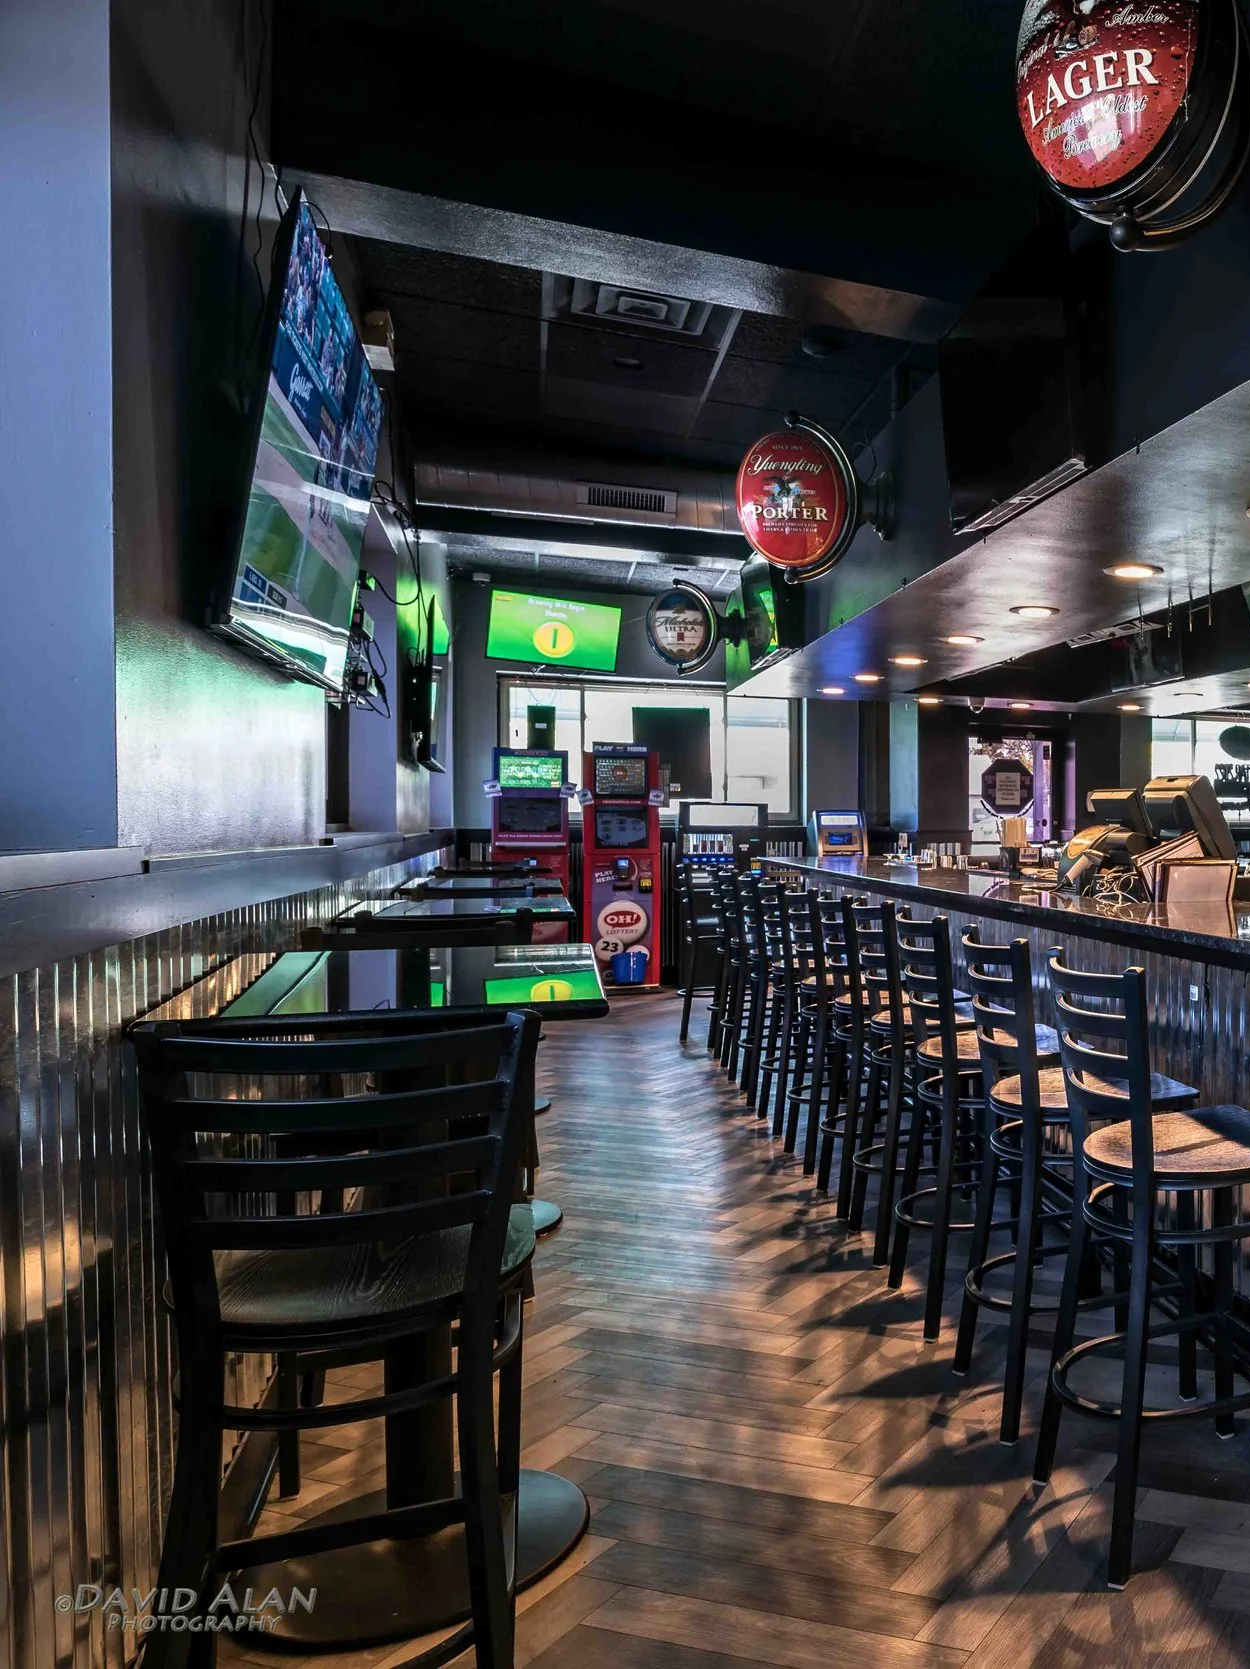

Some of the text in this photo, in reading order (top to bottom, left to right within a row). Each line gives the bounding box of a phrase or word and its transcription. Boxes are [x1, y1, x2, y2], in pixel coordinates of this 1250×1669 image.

[1105, 4, 1169, 27] Amber
[1026, 49, 1159, 129] LAGER
[747, 454, 824, 476] Yuengling
[752, 504, 829, 521] PORTER
[595, 869, 613, 878] PLAY
[605, 913, 638, 924] OH!
[601, 941, 619, 953] 23
